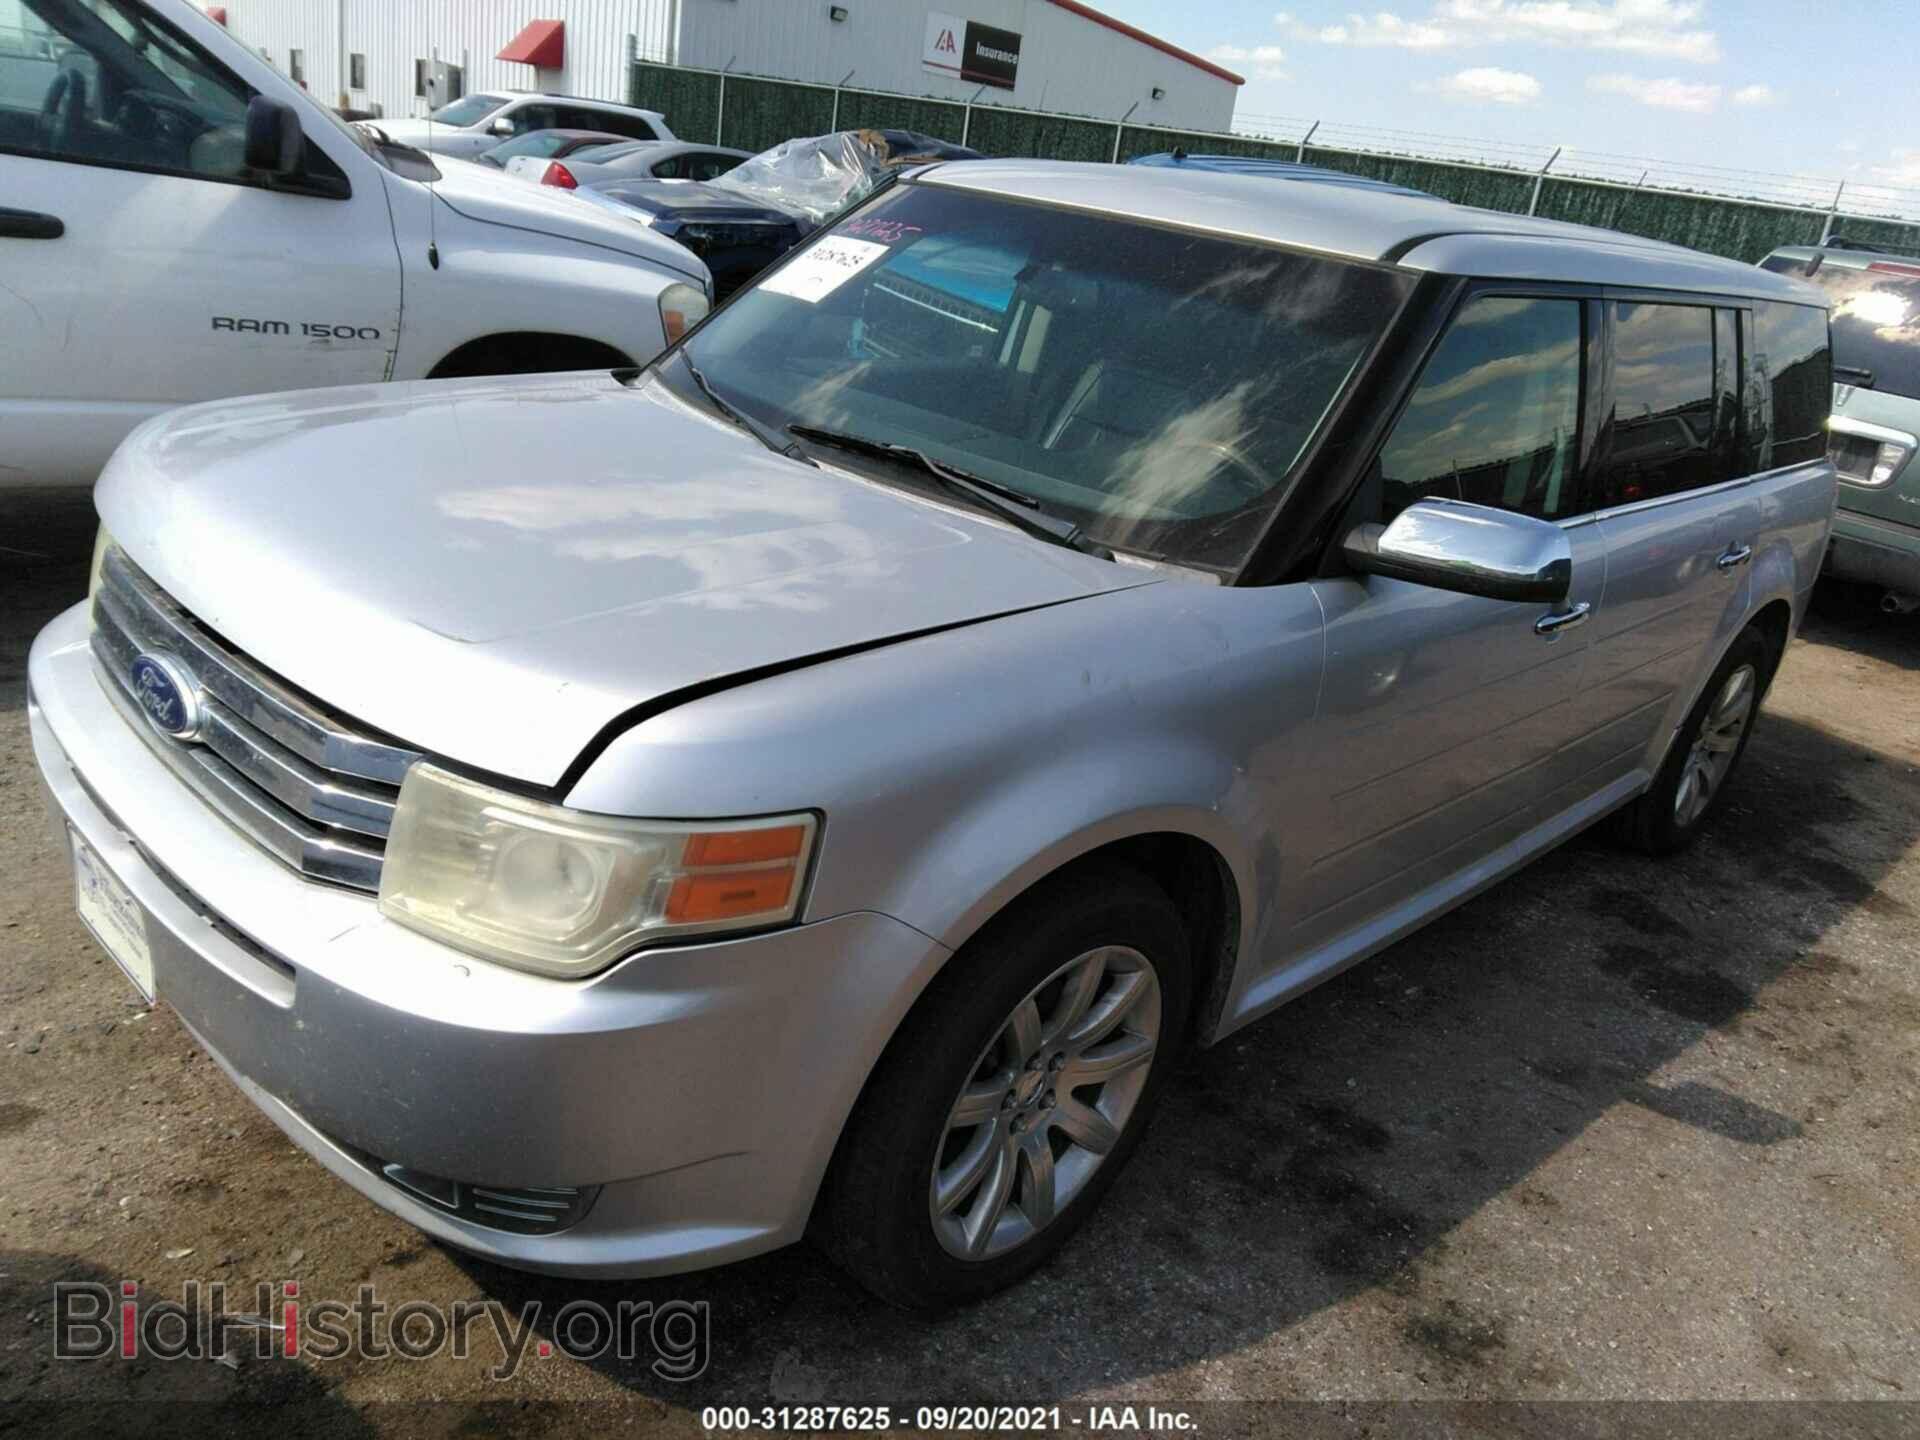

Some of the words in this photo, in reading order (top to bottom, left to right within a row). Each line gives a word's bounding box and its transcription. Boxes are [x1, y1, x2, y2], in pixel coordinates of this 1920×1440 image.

[976, 41, 1018, 65] Insurance
[211, 316, 290, 335] RAM
[300, 322, 381, 340] 1500
[136, 666, 173, 721] Ford
